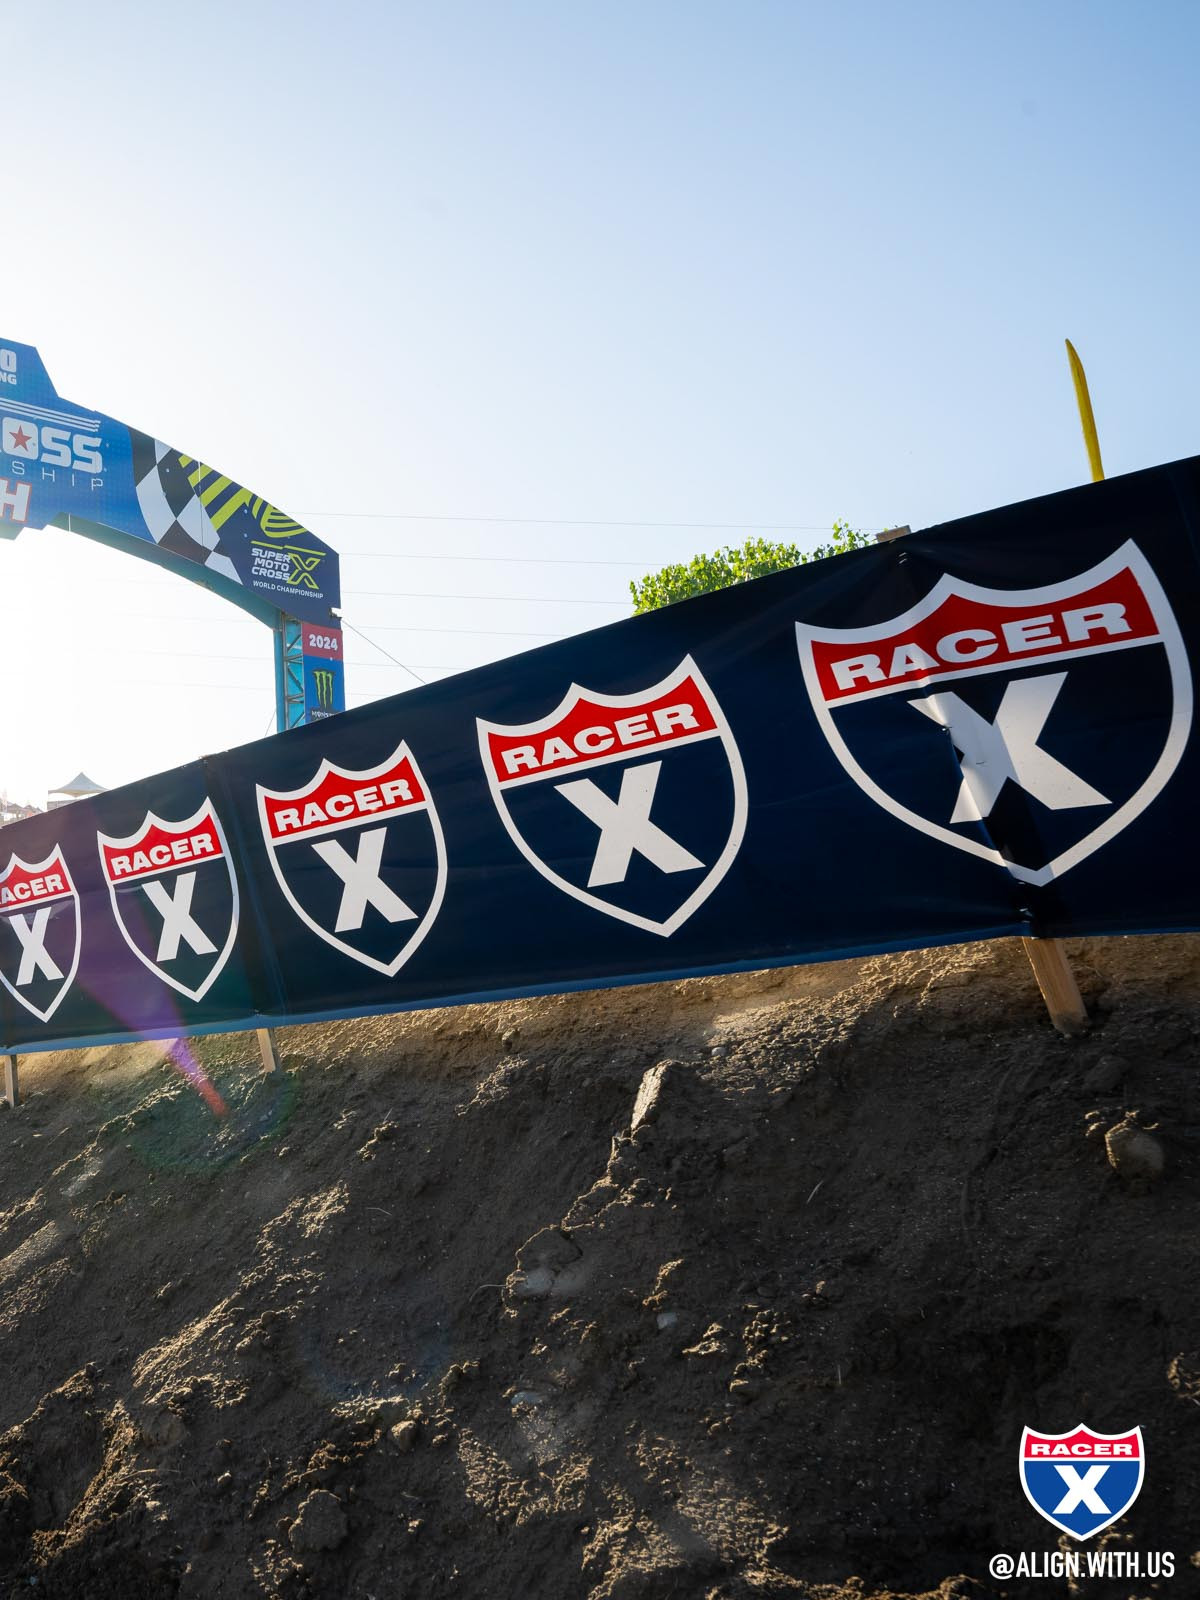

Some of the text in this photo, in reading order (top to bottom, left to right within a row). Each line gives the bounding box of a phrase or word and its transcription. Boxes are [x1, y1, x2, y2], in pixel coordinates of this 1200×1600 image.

[251, 548, 291, 563] SUPER
[251, 567, 291, 581] CROSS
[254, 558, 290, 571] MOTO
[253, 580, 323, 599] WORLD CHAMPIONSHIP
[309, 634, 338, 651] 2024
[830, 602, 1135, 692] RACER
[501, 703, 700, 776] RACER
[907, 671, 1113, 824] X
[273, 779, 413, 832] RACER
[554, 760, 706, 888] X
[110, 832, 215, 876] RACER
[311, 827, 419, 932] X
[9, 908, 64, 986] X
[142, 872, 218, 962] X
